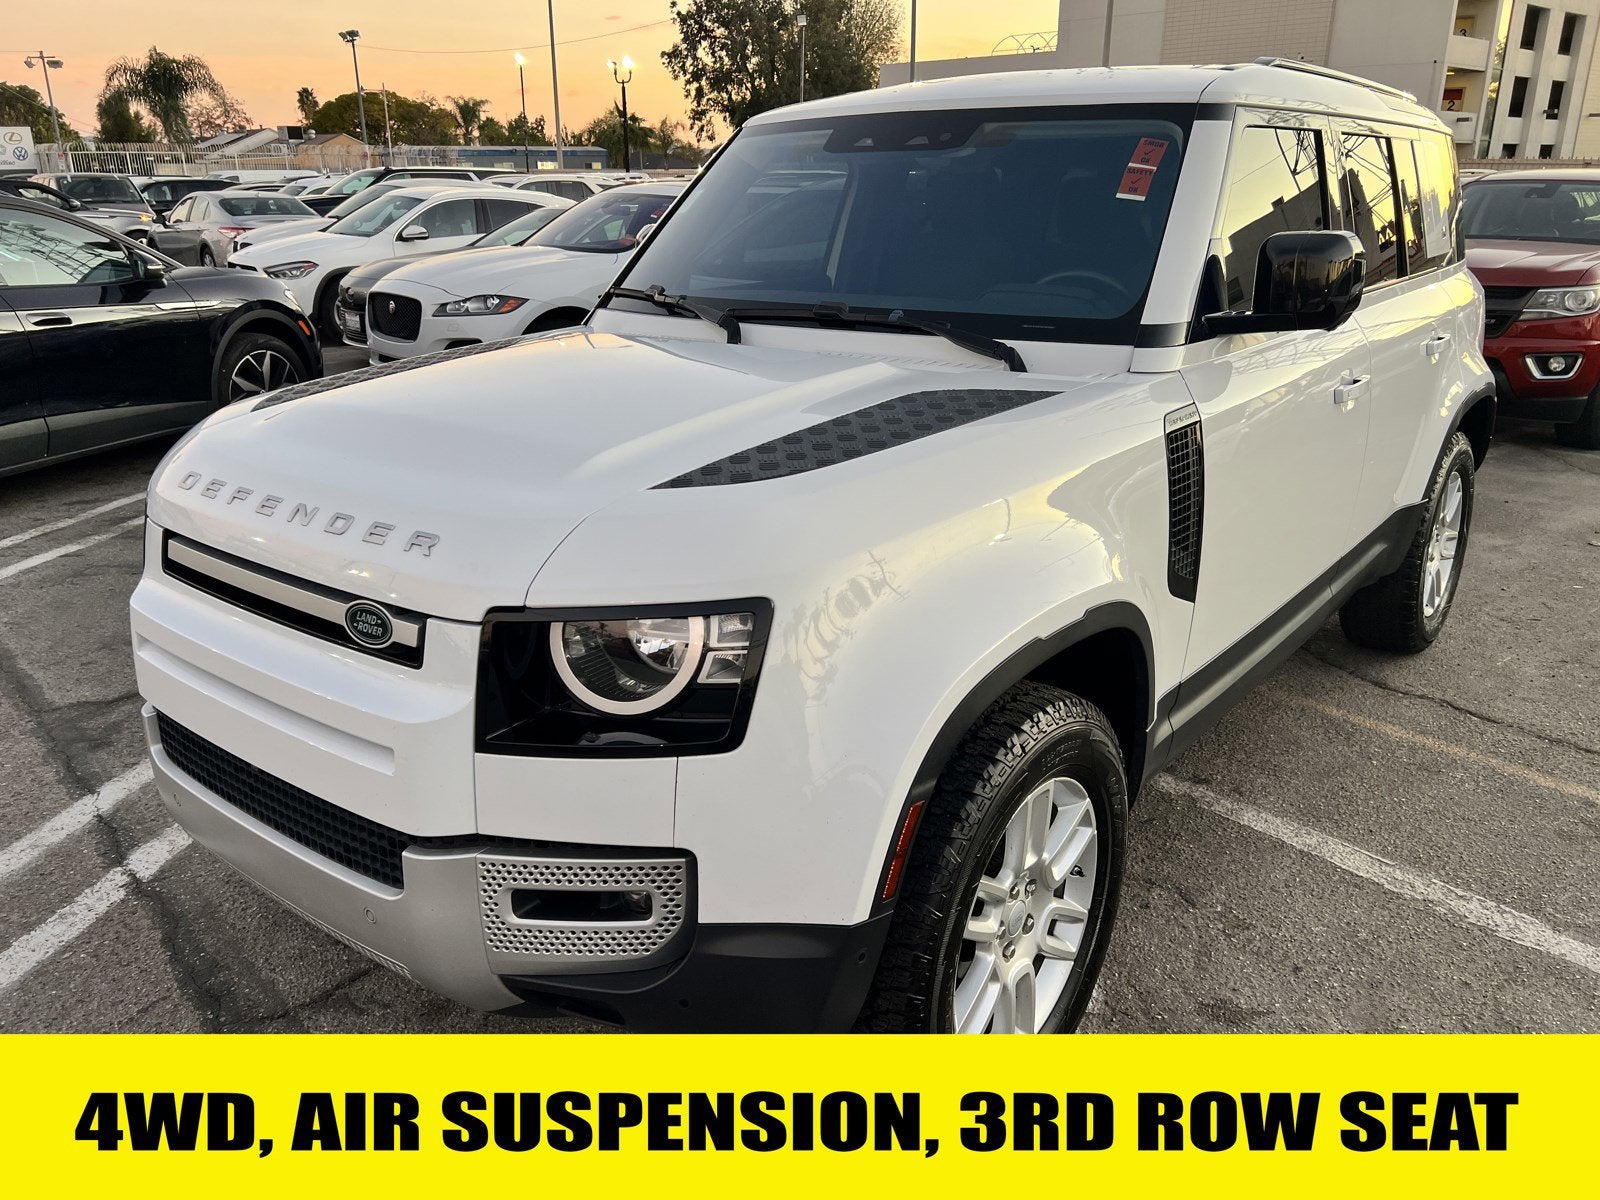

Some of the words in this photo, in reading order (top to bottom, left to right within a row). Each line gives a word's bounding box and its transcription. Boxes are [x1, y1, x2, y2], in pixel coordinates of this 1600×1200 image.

[1459, 28, 1467, 37] 3
[1446, 100, 1456, 111] 2
[177, 470, 441, 557] DEFENDER
